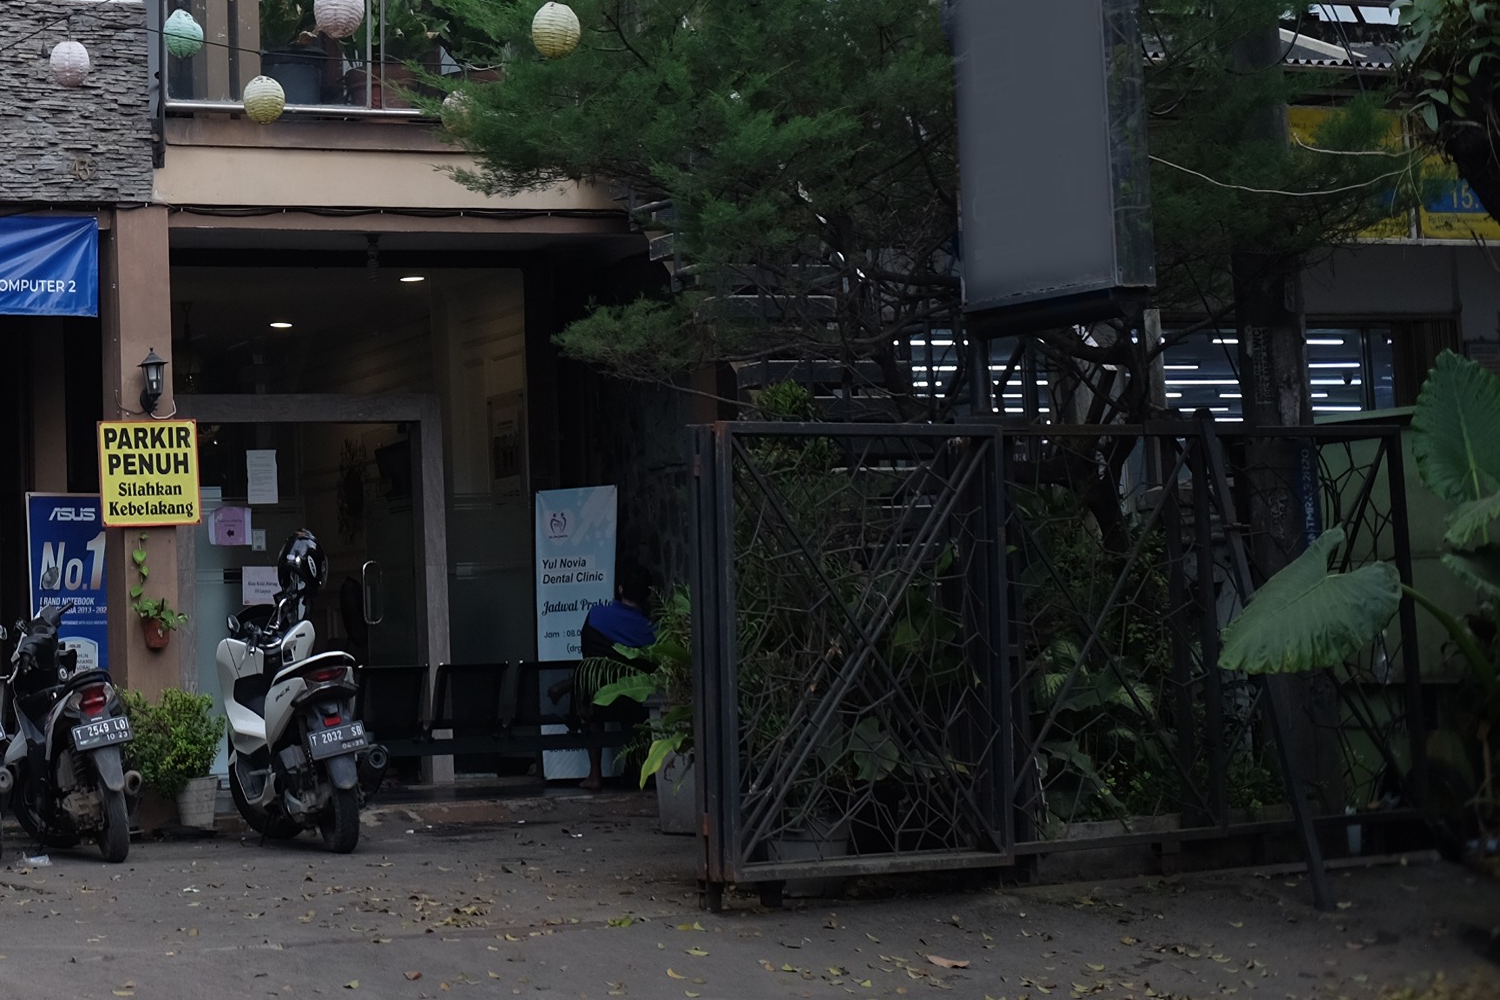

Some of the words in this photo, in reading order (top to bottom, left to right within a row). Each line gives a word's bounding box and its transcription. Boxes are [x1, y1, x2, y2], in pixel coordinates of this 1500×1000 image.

[68, 281, 77, 294] 2
[103, 426, 191, 450] PARKIR
[108, 452, 189, 476] PENUH
[118, 482, 182, 497] Silahkan
[49, 507, 96, 521] ASUS
[108, 500, 194, 518] Kebelakang
[39, 531, 107, 591] No.1
[542, 558, 557, 569] Yul
[560, 557, 586, 568] Novia
[542, 573, 573, 584] Dental
[576, 571, 604, 583] Clinic
[62, 597, 95, 605] NOTEBOOK
[542, 599, 578, 615] Jadwal
[78, 606, 91, 614] 2013
[76, 730, 81, 740] T
[87, 723, 109, 737] 2549
[312, 736, 317, 746] T
[321, 730, 343, 744] 2032
[350, 725, 362, 736] SB
